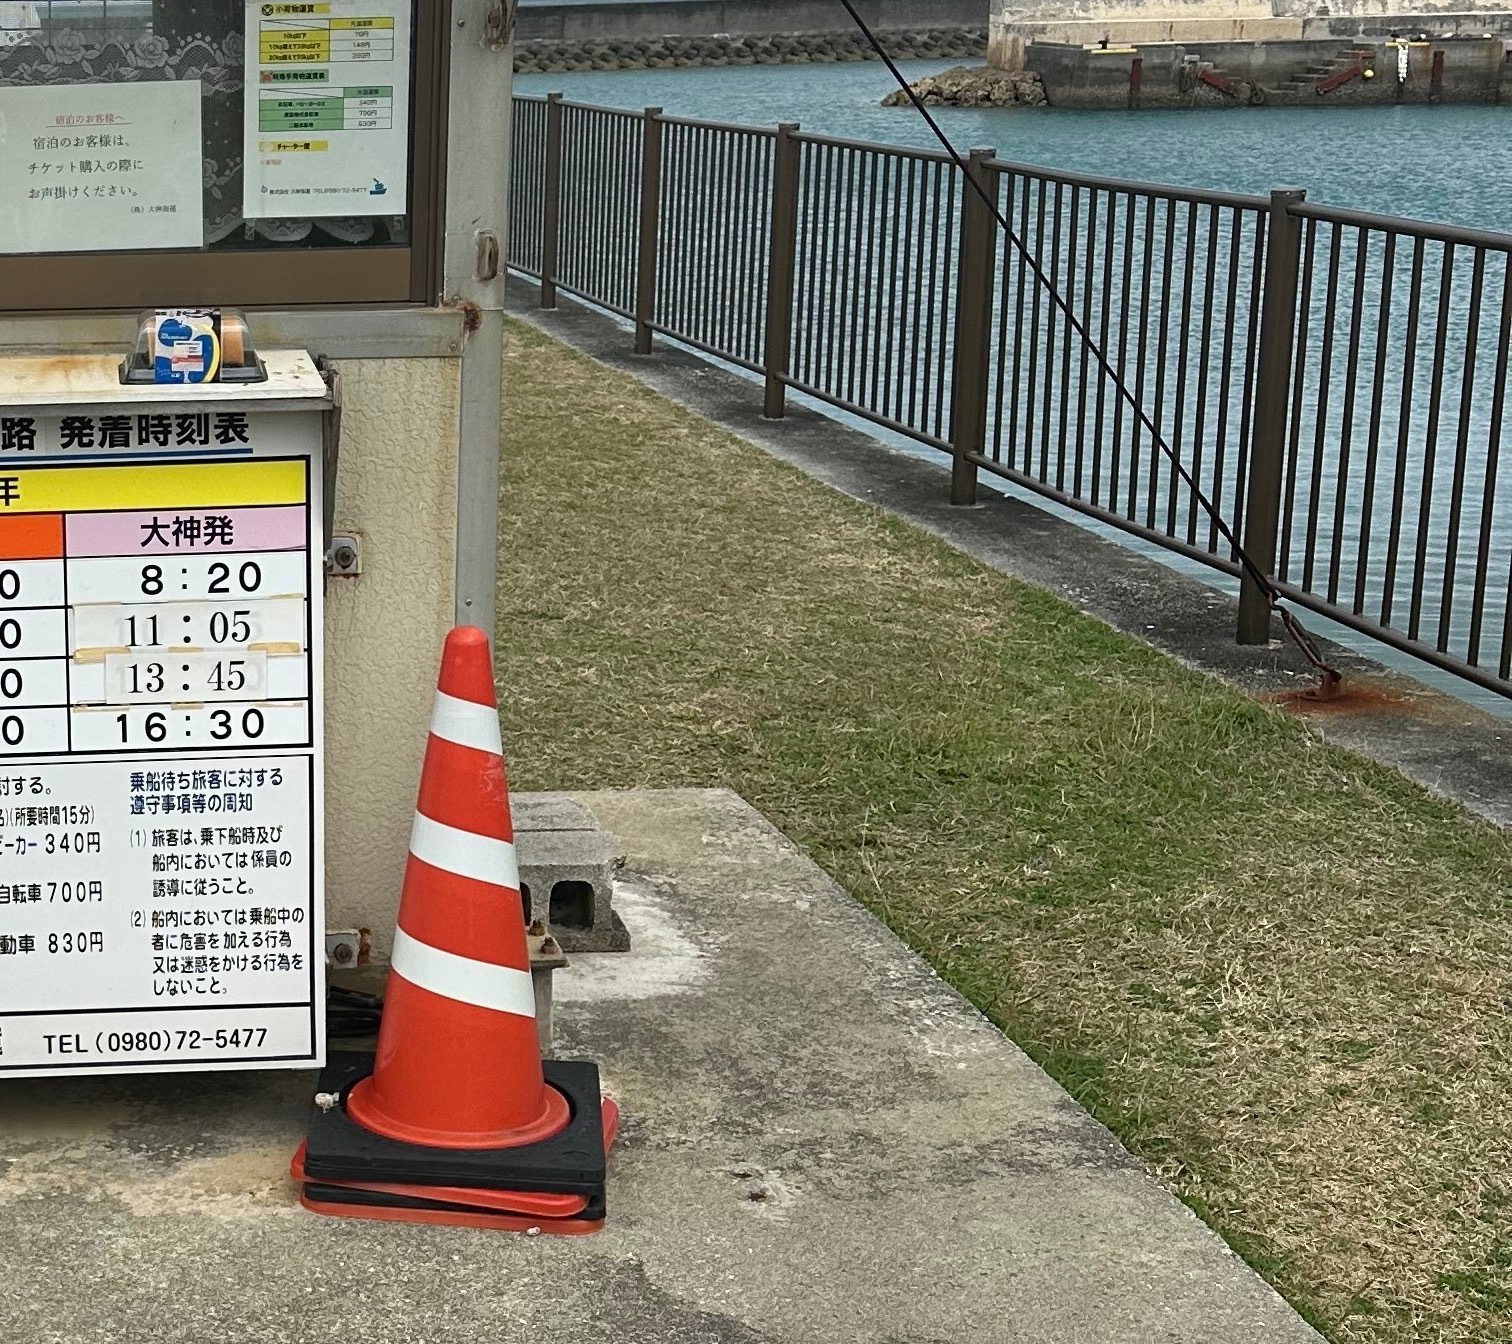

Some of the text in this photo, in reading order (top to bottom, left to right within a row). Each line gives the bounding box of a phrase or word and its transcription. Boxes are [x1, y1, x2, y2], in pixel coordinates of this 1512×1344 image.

[55, 112, 125, 126] 宿泊のお客様へ
[32, 133, 131, 151] 宿泊のお客様は、
[27, 158, 145, 175] チケット購入の際に
[27, 185, 139, 201] お声掛けください。
[58, 410, 252, 452] 発着時刻表
[138, 516, 235, 549] 大神発
[139, 560, 263, 596] 8:20
[124, 609, 252, 649] 11:05
[125, 658, 246, 695] 13:45
[115, 706, 266, 743] 16:30
[129, 767, 284, 793] 乗船待ち旅客に対する
[129, 792, 254, 816] 遵守事項等の周知
[44, 831, 101, 855] 340円
[151, 824, 284, 848] 旅客は、乗下船時及び
[46, 880, 103, 904] 700円
[152, 877, 255, 898] 誘導に従うこと。
[150, 906, 305, 929] 船内においては乗船中の
[47, 930, 104, 954] 830円
[152, 952, 305, 975] 又は迷惑をかける行為を
[152, 976, 228, 997] しないこと。
[44, 1032, 89, 1055] TEL
[94, 1026, 269, 1054] (0980)72-5477
